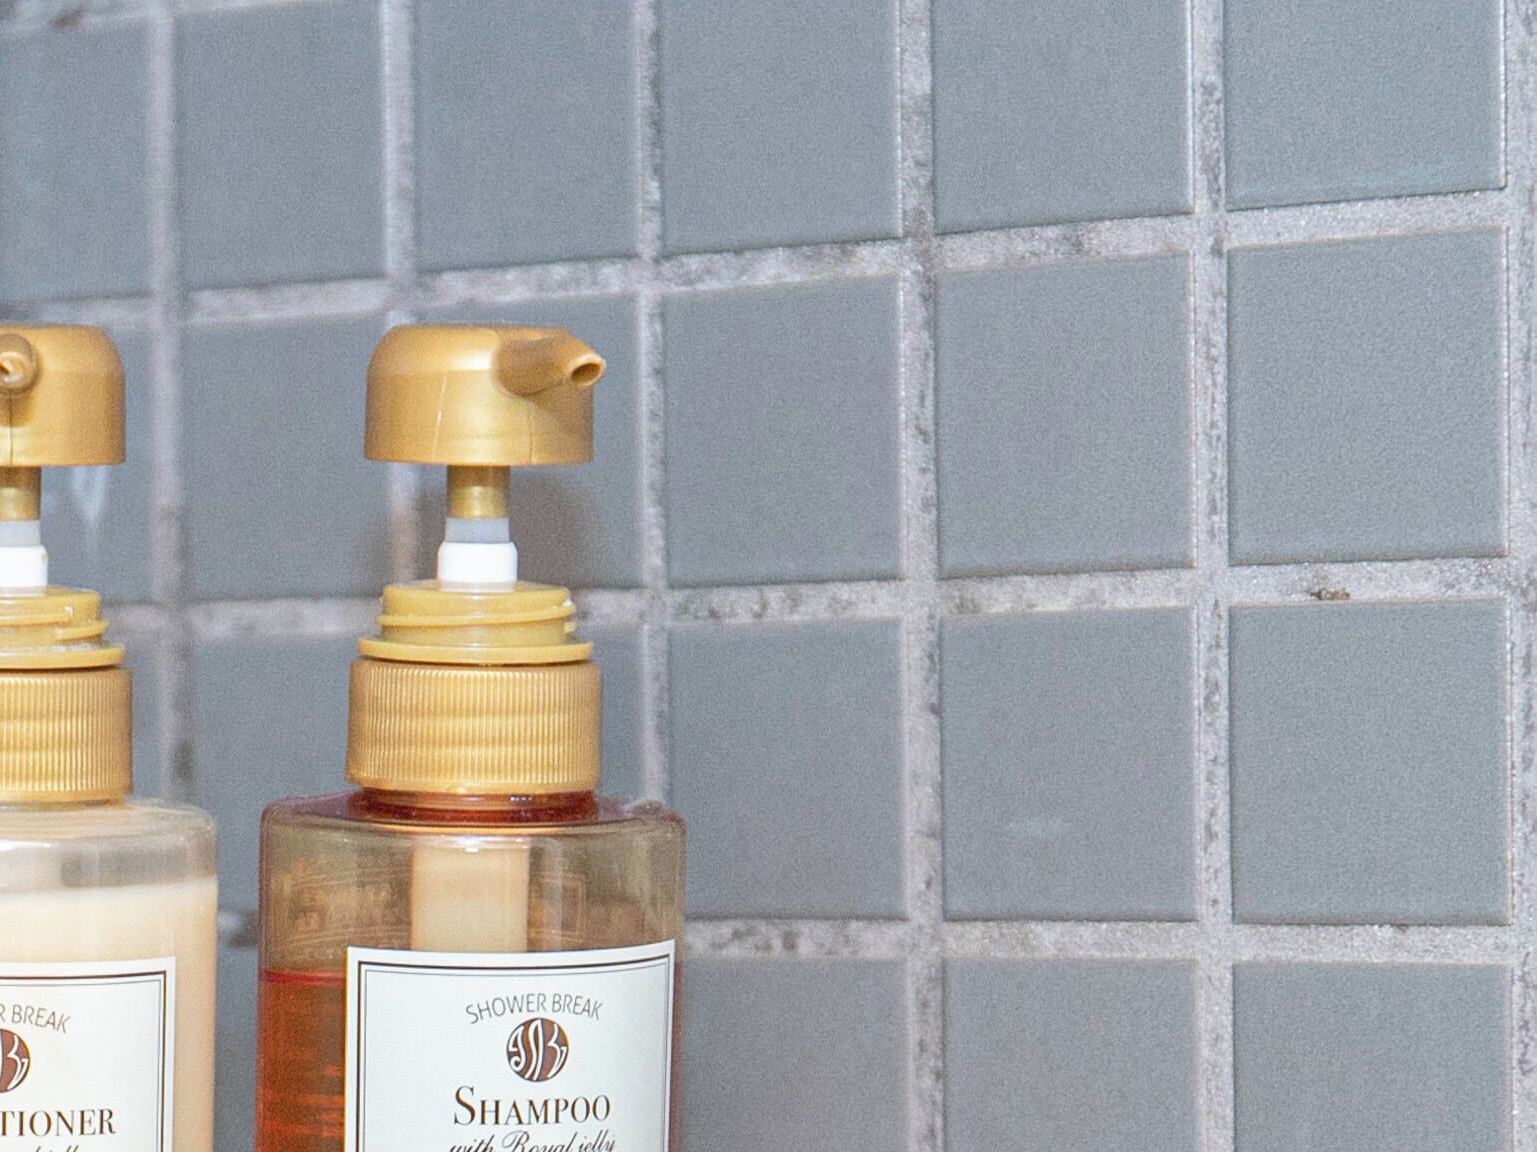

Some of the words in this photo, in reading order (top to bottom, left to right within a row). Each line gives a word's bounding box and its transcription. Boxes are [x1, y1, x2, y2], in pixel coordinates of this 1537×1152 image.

[11, 1004, 71, 1033] BREAK
[465, 994, 547, 1024] SHOWER
[552, 993, 603, 1020] BREAK
[454, 1086, 610, 1125] SHAMPOO
